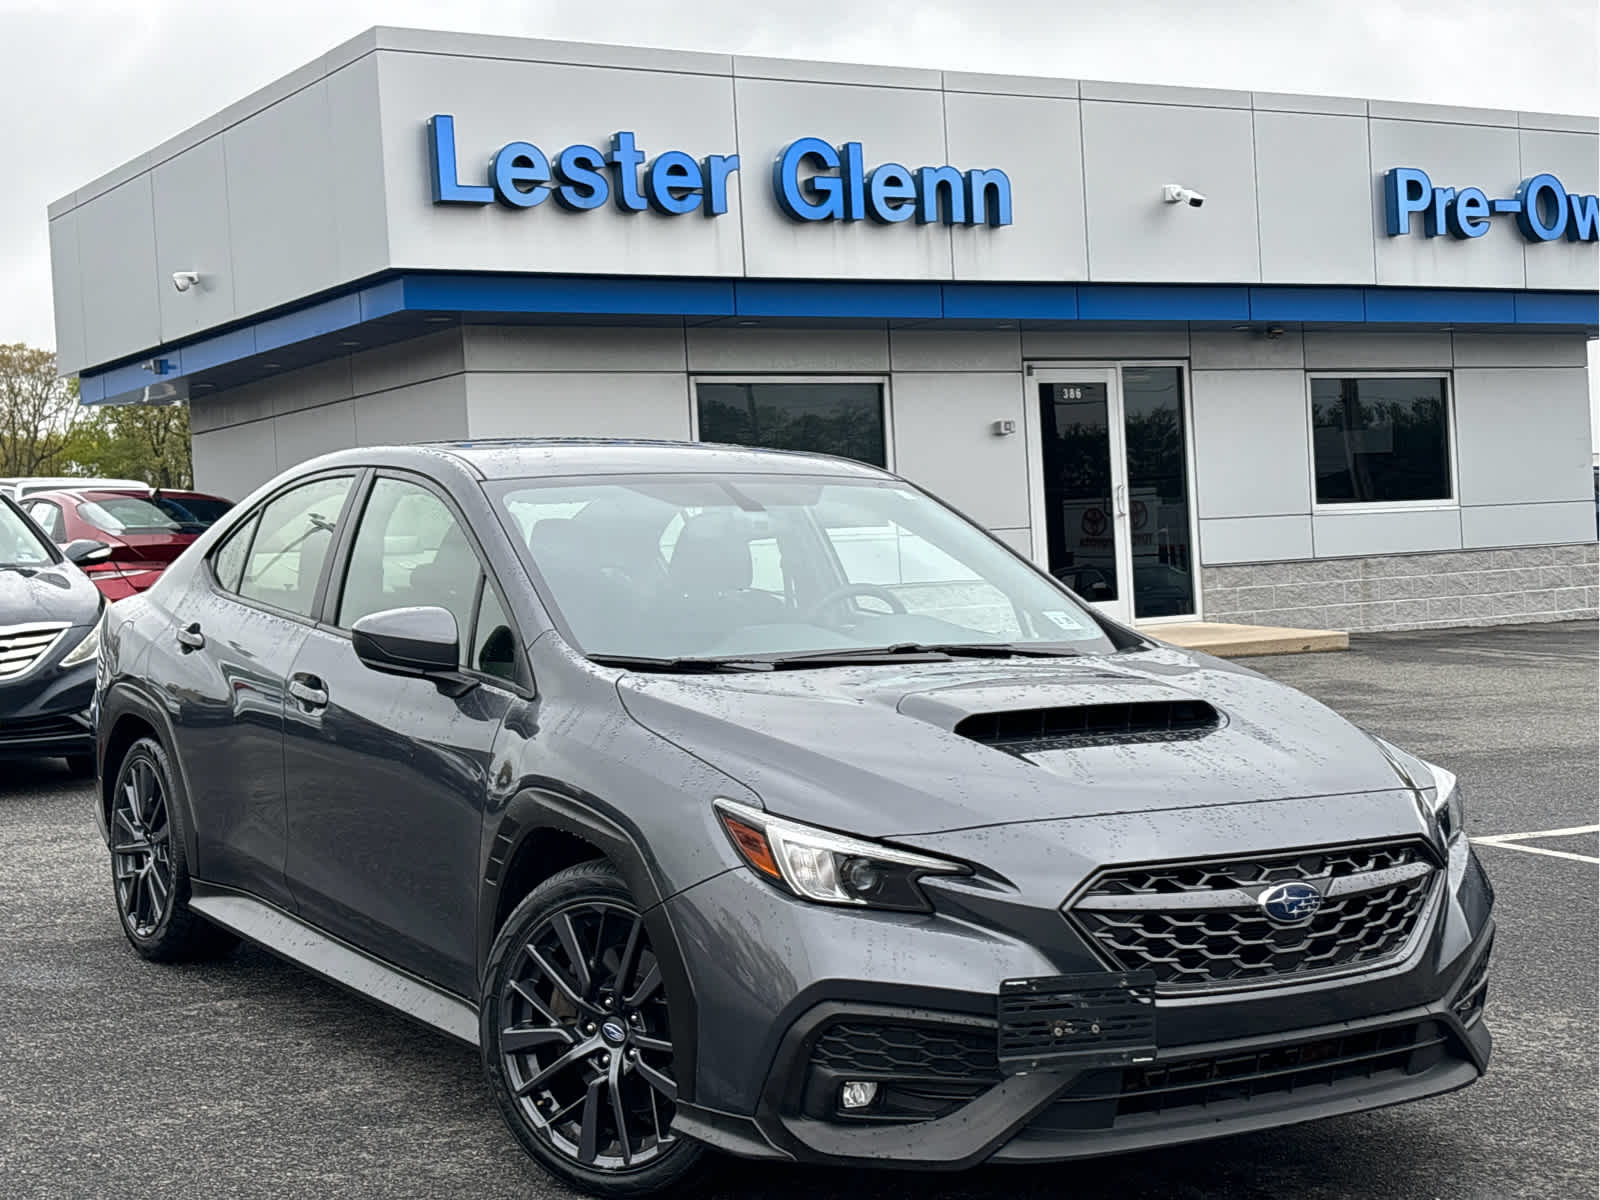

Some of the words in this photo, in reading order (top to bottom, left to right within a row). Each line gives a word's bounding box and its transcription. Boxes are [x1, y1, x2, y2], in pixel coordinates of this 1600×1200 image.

[427, 113, 739, 217] Lester
[775, 136, 1013, 226] Glenn
[1062, 388, 1082, 399] 386
